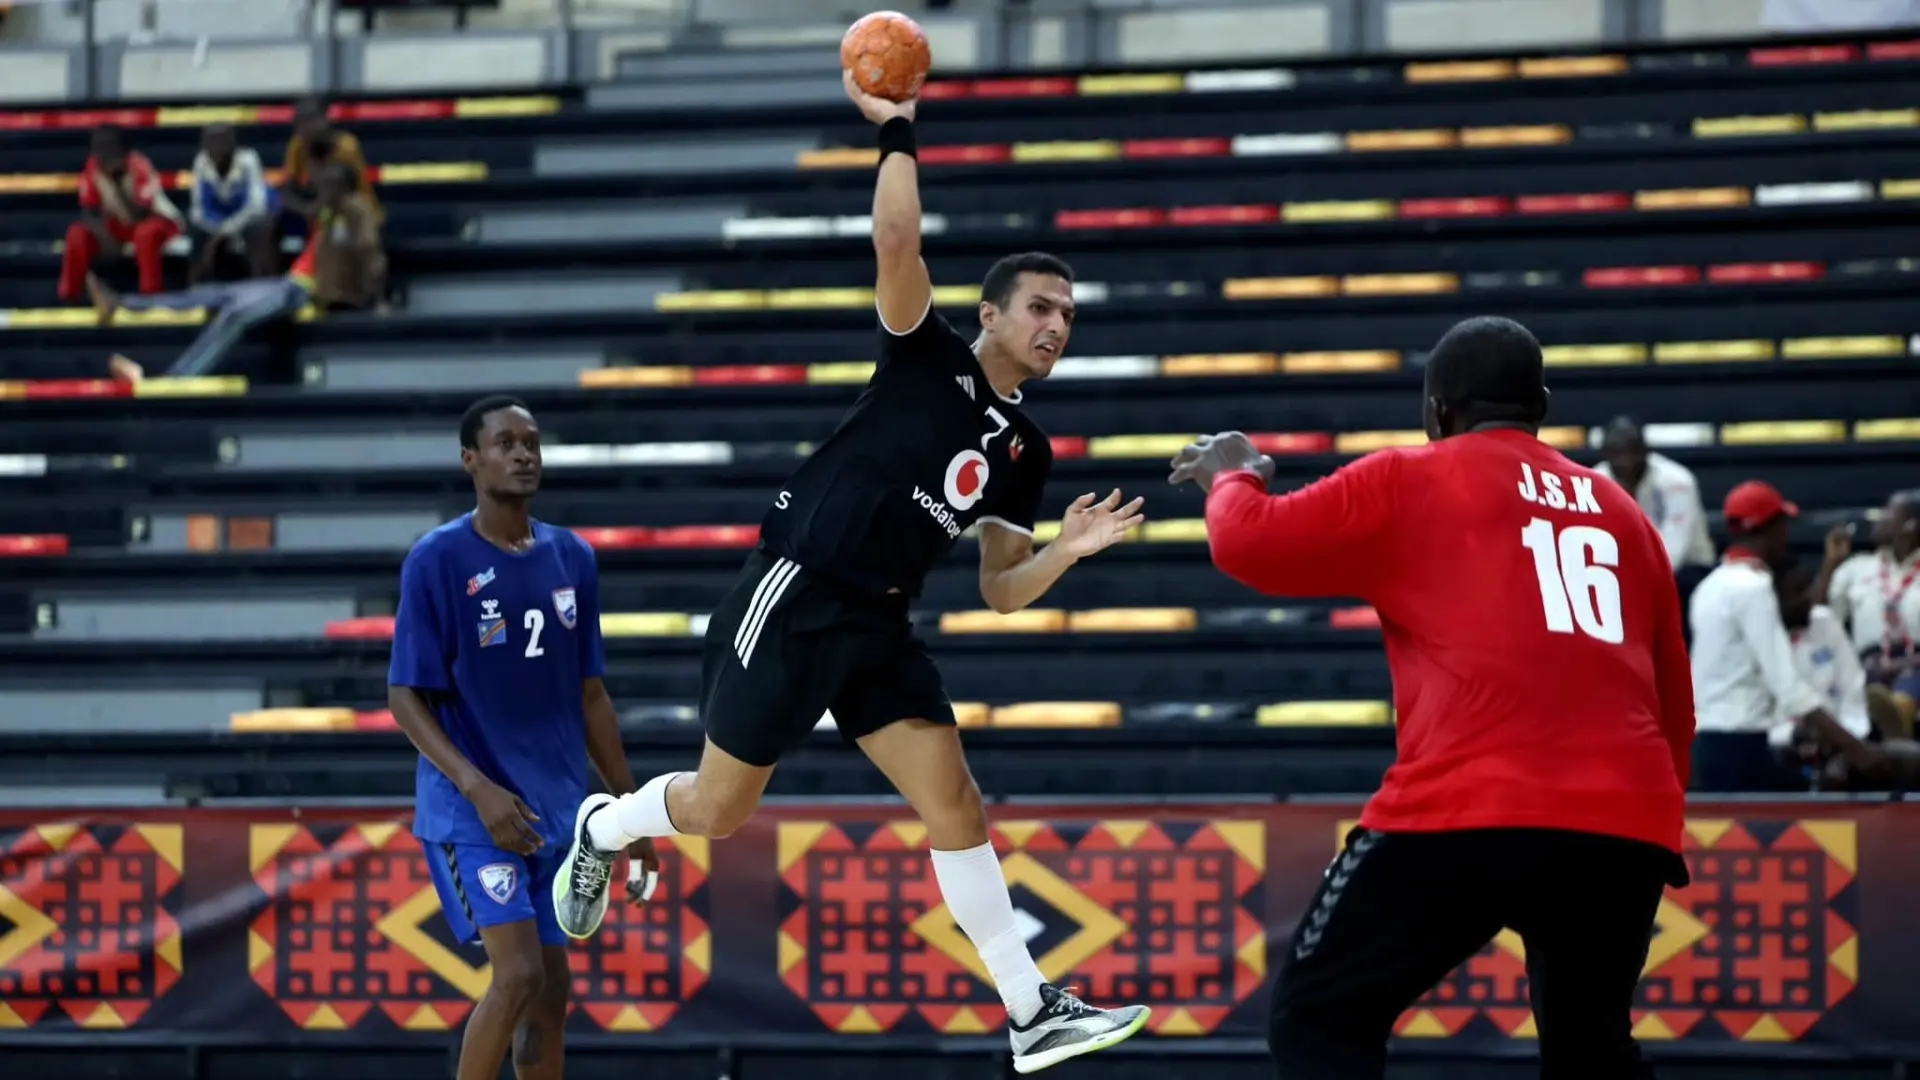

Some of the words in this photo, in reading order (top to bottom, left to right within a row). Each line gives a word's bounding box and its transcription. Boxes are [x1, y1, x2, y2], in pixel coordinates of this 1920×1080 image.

[980, 405, 1010, 451] 7
[911, 485, 961, 540] vodafoe
[1517, 461, 1603, 515] J.S.K
[1521, 516, 1625, 645] 16
[523, 609, 545, 658] 2
